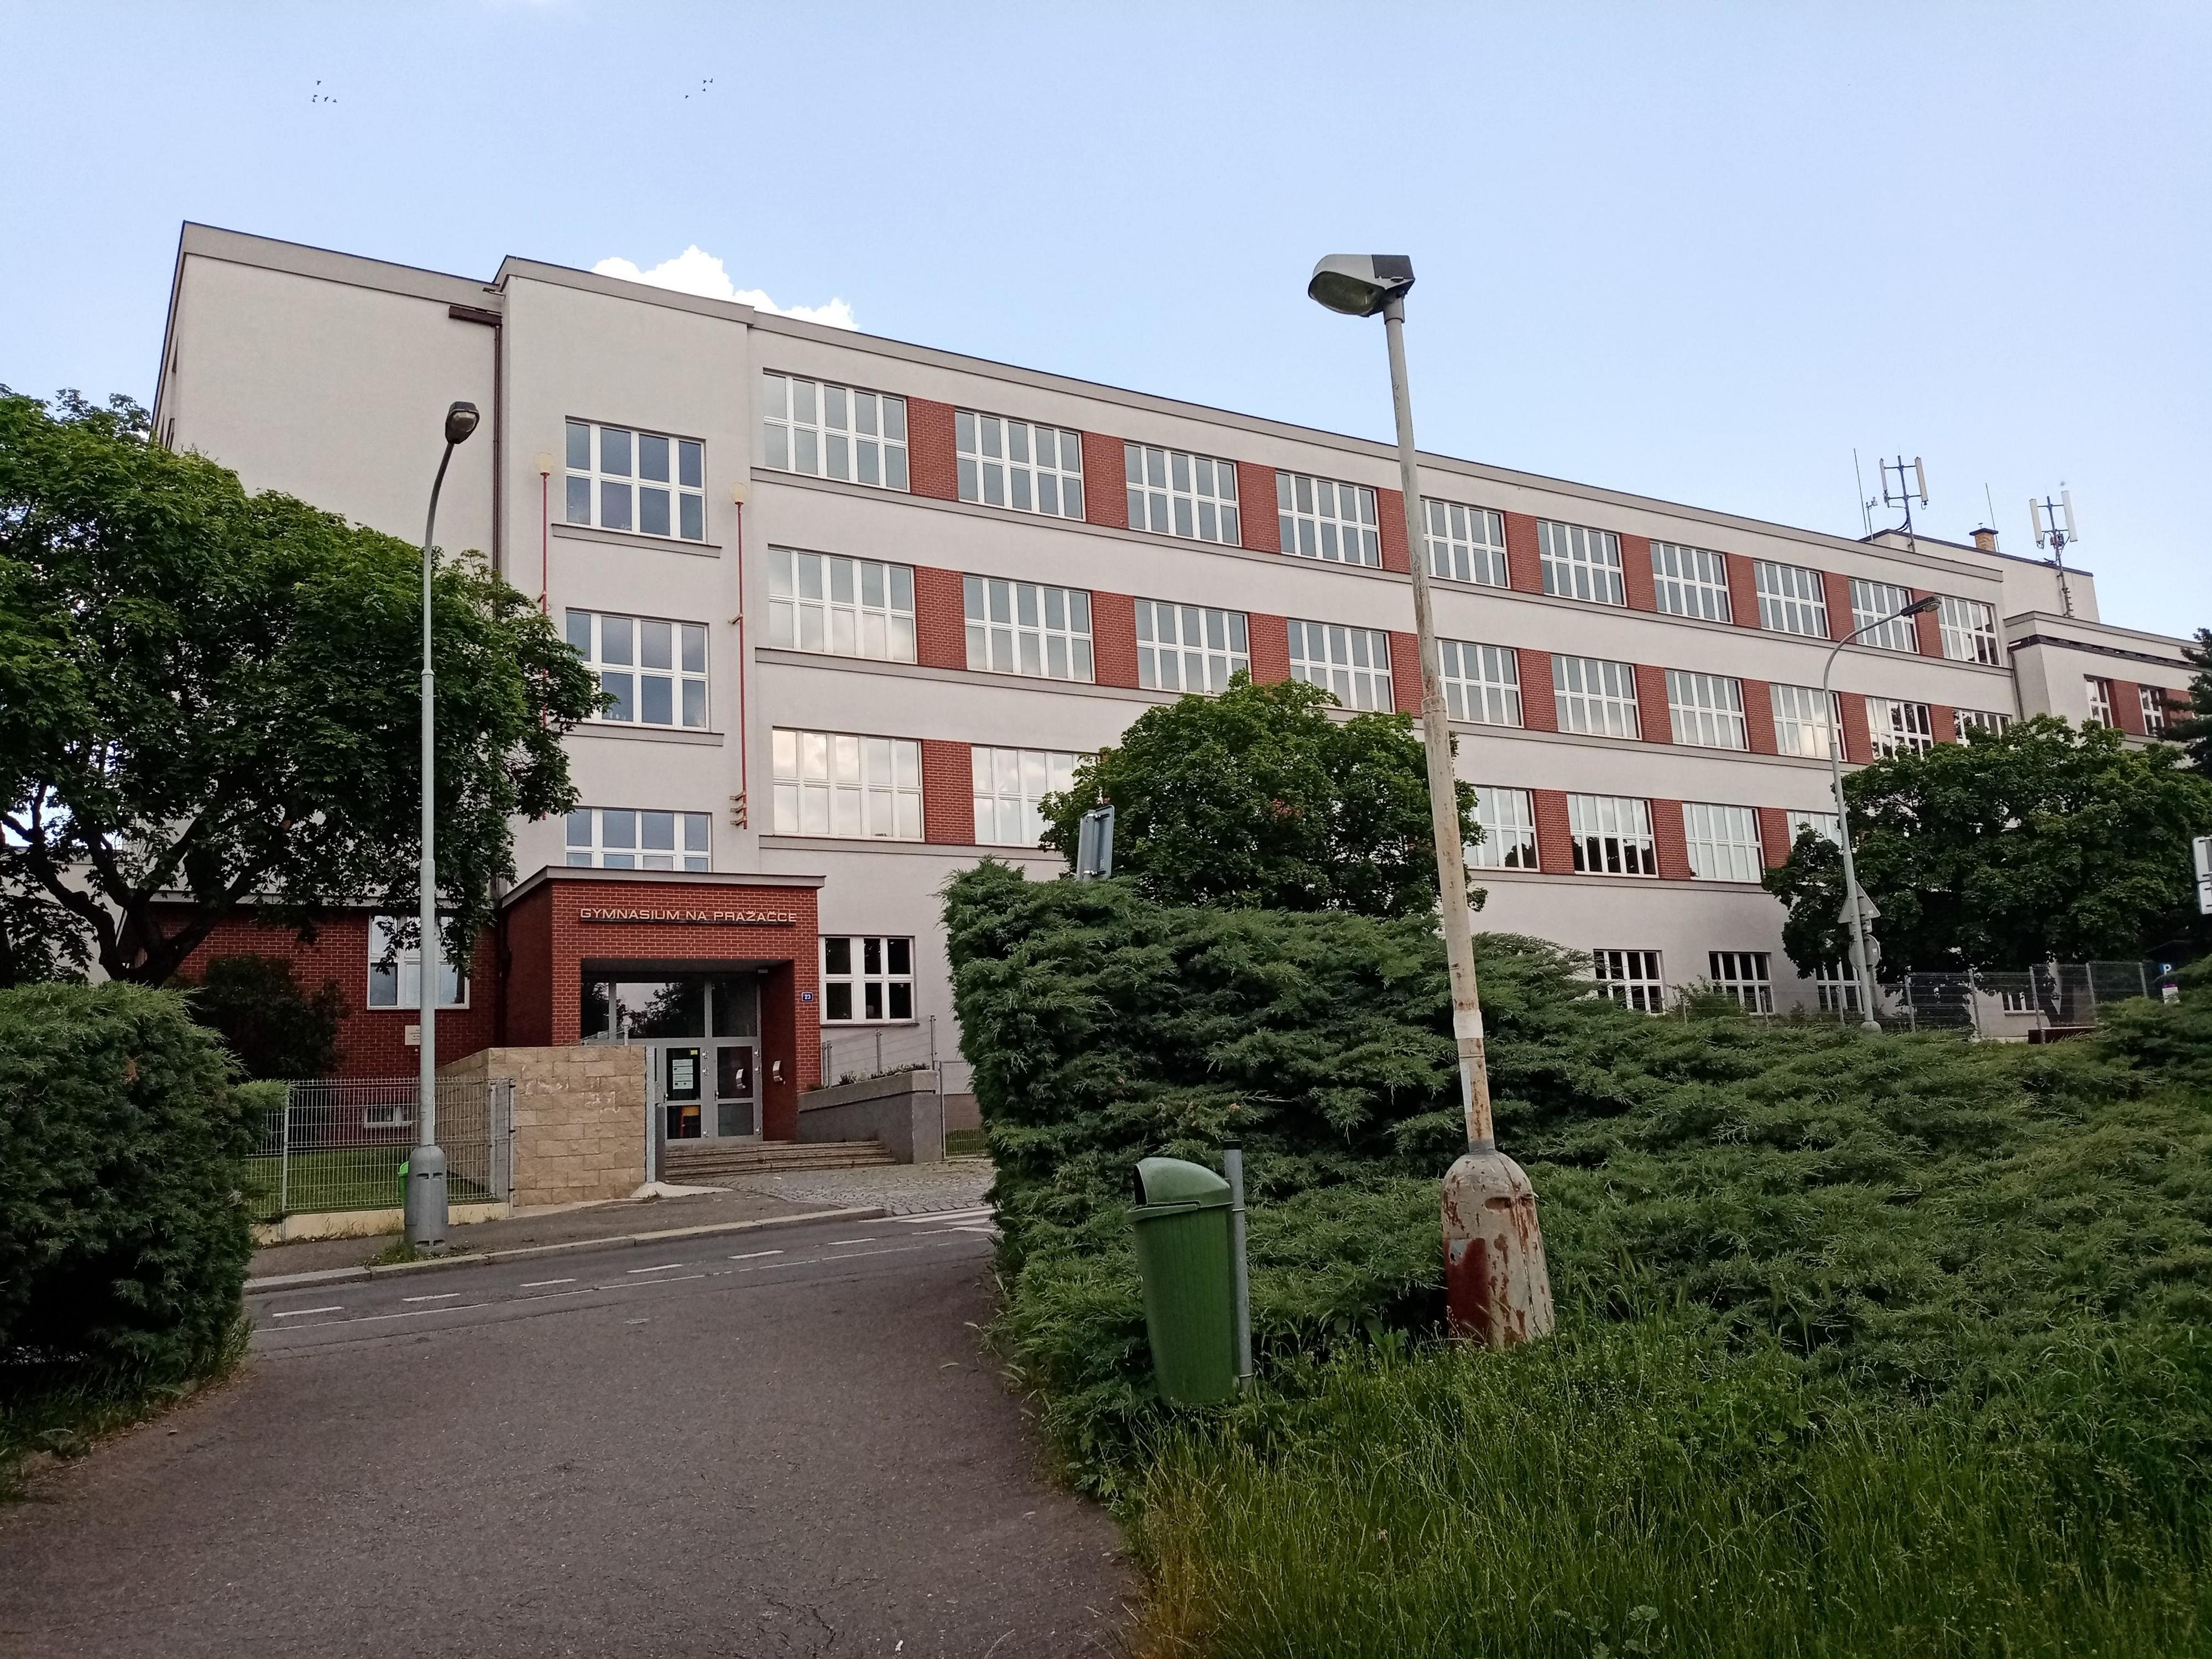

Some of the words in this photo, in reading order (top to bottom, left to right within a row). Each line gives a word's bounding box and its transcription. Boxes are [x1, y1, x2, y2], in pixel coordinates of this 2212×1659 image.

[581, 909, 680, 920] GYMNASIUM
[686, 911, 707, 921] NA
[713, 910, 797, 922] PRAŽAČCE
[2163, 964, 2172, 975] P
